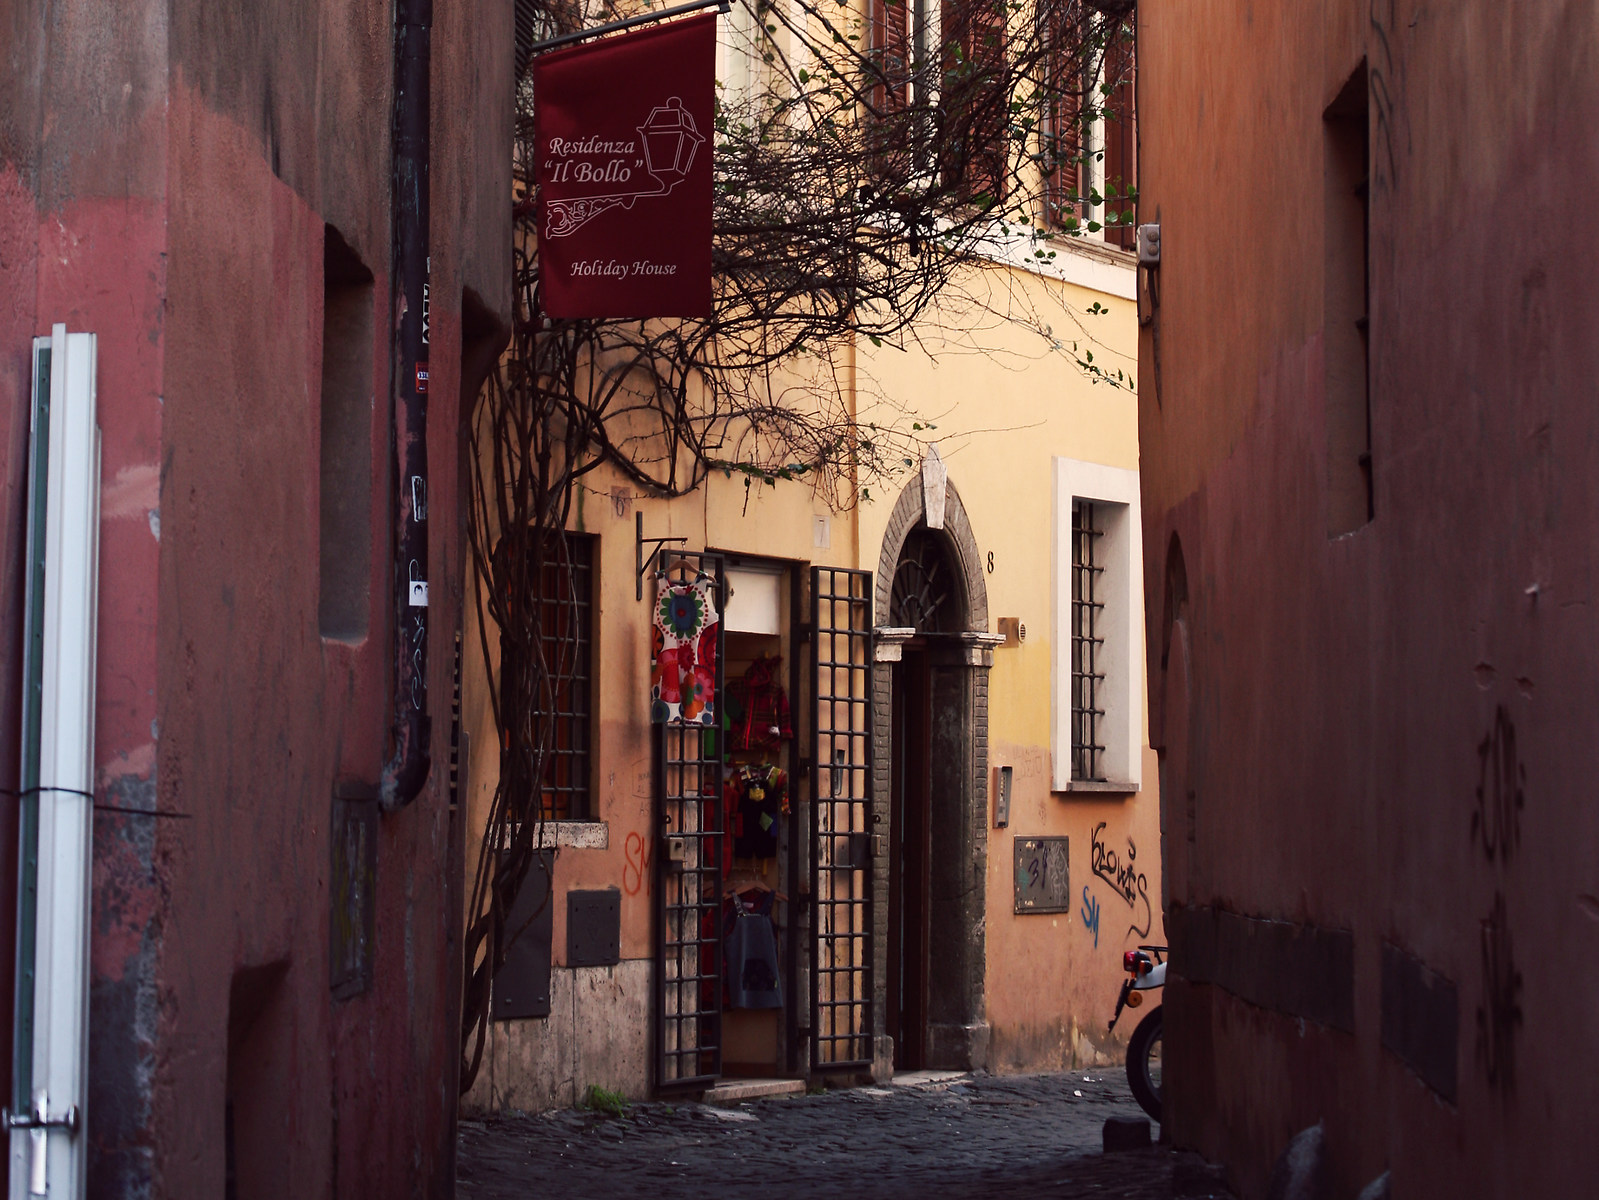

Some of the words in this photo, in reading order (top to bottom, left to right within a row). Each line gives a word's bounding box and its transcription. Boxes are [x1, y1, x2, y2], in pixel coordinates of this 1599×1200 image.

[549, 135, 635, 157] Residenza
[570, 259, 629, 280] Holiday
[631, 260, 677, 275] House
[987, 550, 994, 574] 8
